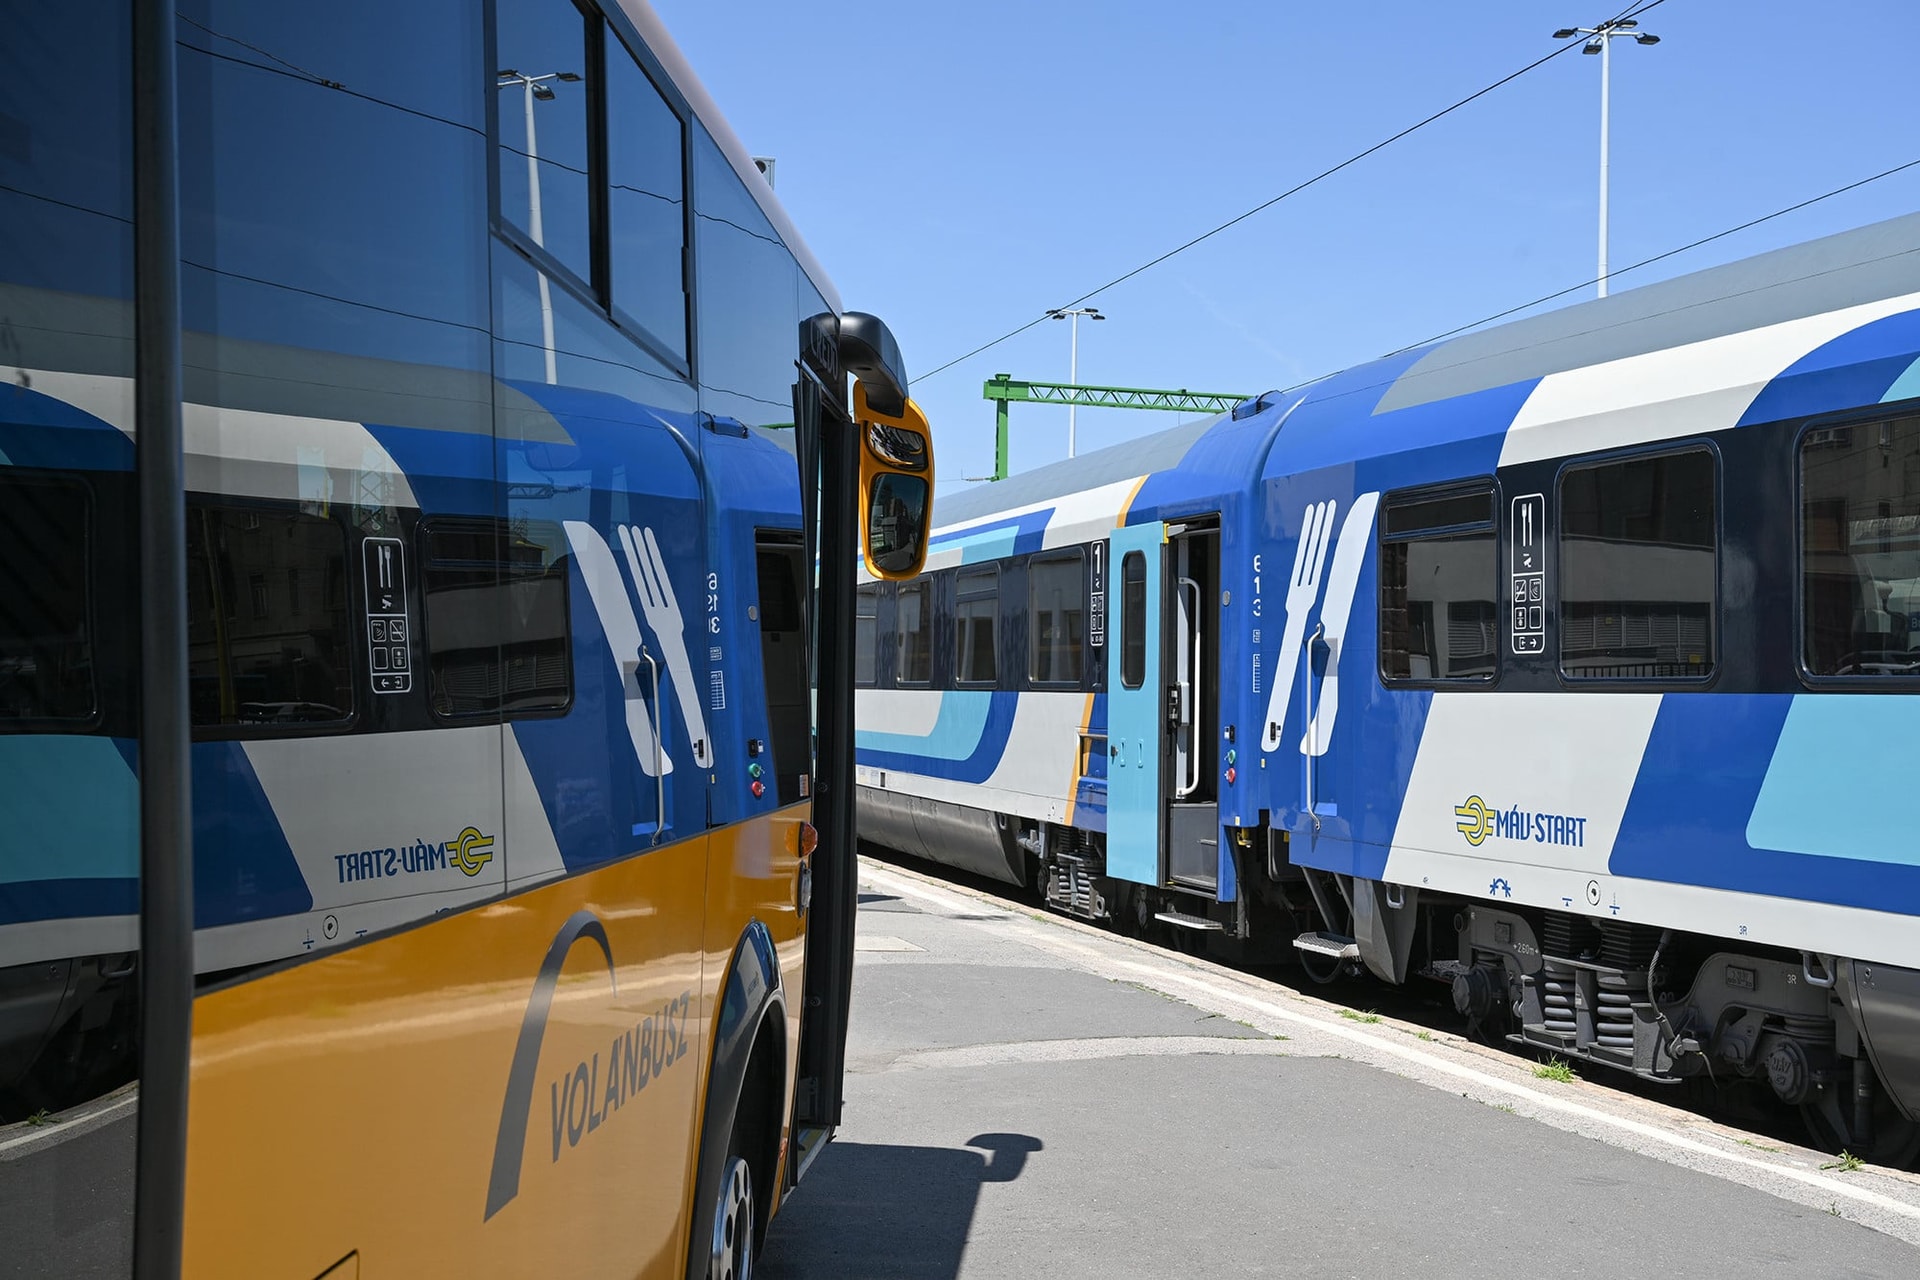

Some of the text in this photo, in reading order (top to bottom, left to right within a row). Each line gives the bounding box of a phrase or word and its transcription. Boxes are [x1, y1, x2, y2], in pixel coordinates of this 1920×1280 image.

[1495, 803, 1587, 848] MÁV-START
[1738, 924, 1748, 936] 3R
[1786, 974, 1797, 985] 3R
[550, 989, 691, 1165] VOLÁNBUSZ
